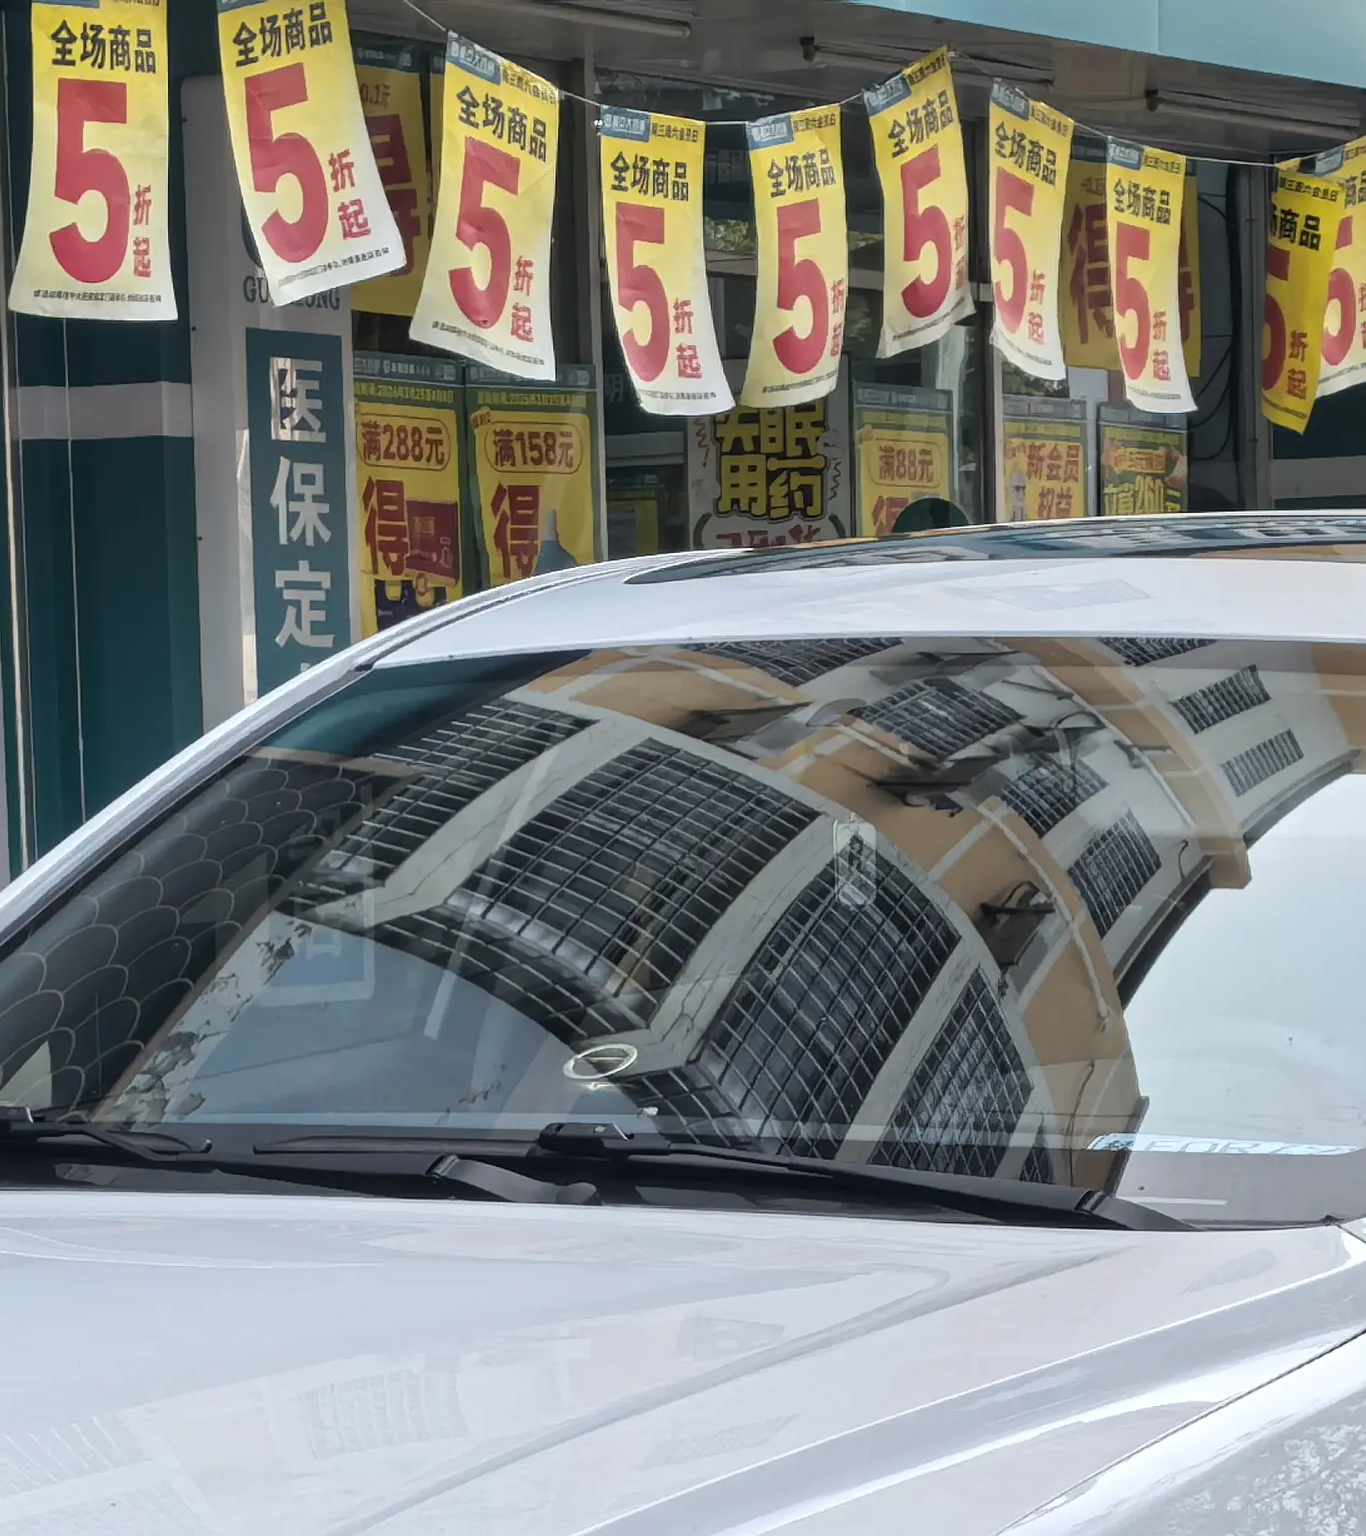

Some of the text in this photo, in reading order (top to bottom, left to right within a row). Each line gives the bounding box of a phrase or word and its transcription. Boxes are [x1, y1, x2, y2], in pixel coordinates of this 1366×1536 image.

[50, 20, 157, 74] 全场商品
[232, 2, 333, 67] 全场商品
[456, 85, 548, 163] 全场商品
[887, 89, 955, 158] 全场商品
[993, 121, 1059, 188] 全场商品
[48, 78, 153, 284] 5 折起
[244, 62, 329, 264] 5
[328, 149, 372, 241] 折起
[610, 150, 690, 203] 全场商品
[767, 148, 836, 198] 全场商品
[899, 144, 952, 319] 5
[1113, 177, 1172, 226] 全场商品
[448, 135, 521, 329] 5
[510, 255, 535, 343] 折起
[993, 165, 1047, 346] 5 折起
[614, 201, 671, 383] 5
[672, 299, 703, 380] 折起
[772, 198, 830, 376] 5
[1114, 222, 1171, 382] 5 折起
[361, 423, 446, 466] 满288元
[492, 428, 574, 468] 满158元
[878, 445, 935, 485] 满88元
[269, 356, 336, 679] 医保定
